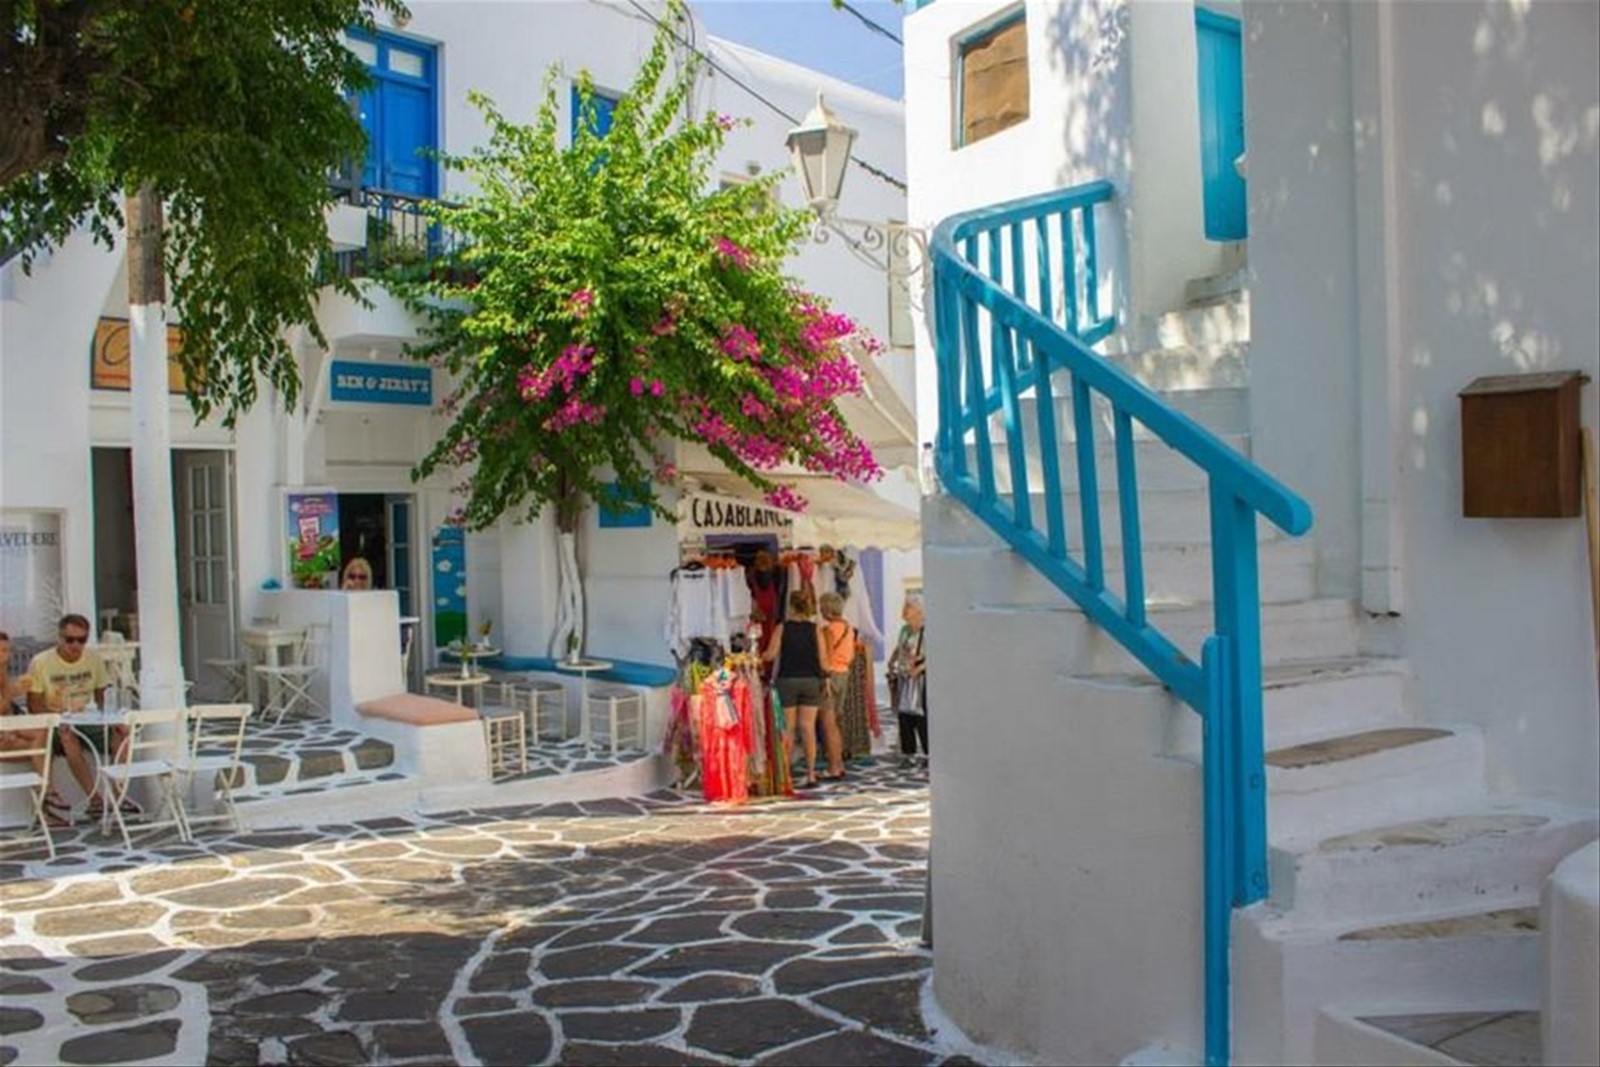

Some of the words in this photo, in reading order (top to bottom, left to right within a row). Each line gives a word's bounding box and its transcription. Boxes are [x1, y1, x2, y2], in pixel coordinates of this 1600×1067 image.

[336, 374, 364, 388] BEN
[366, 376, 378, 390] &
[379, 377, 429, 392] JERRY'S
